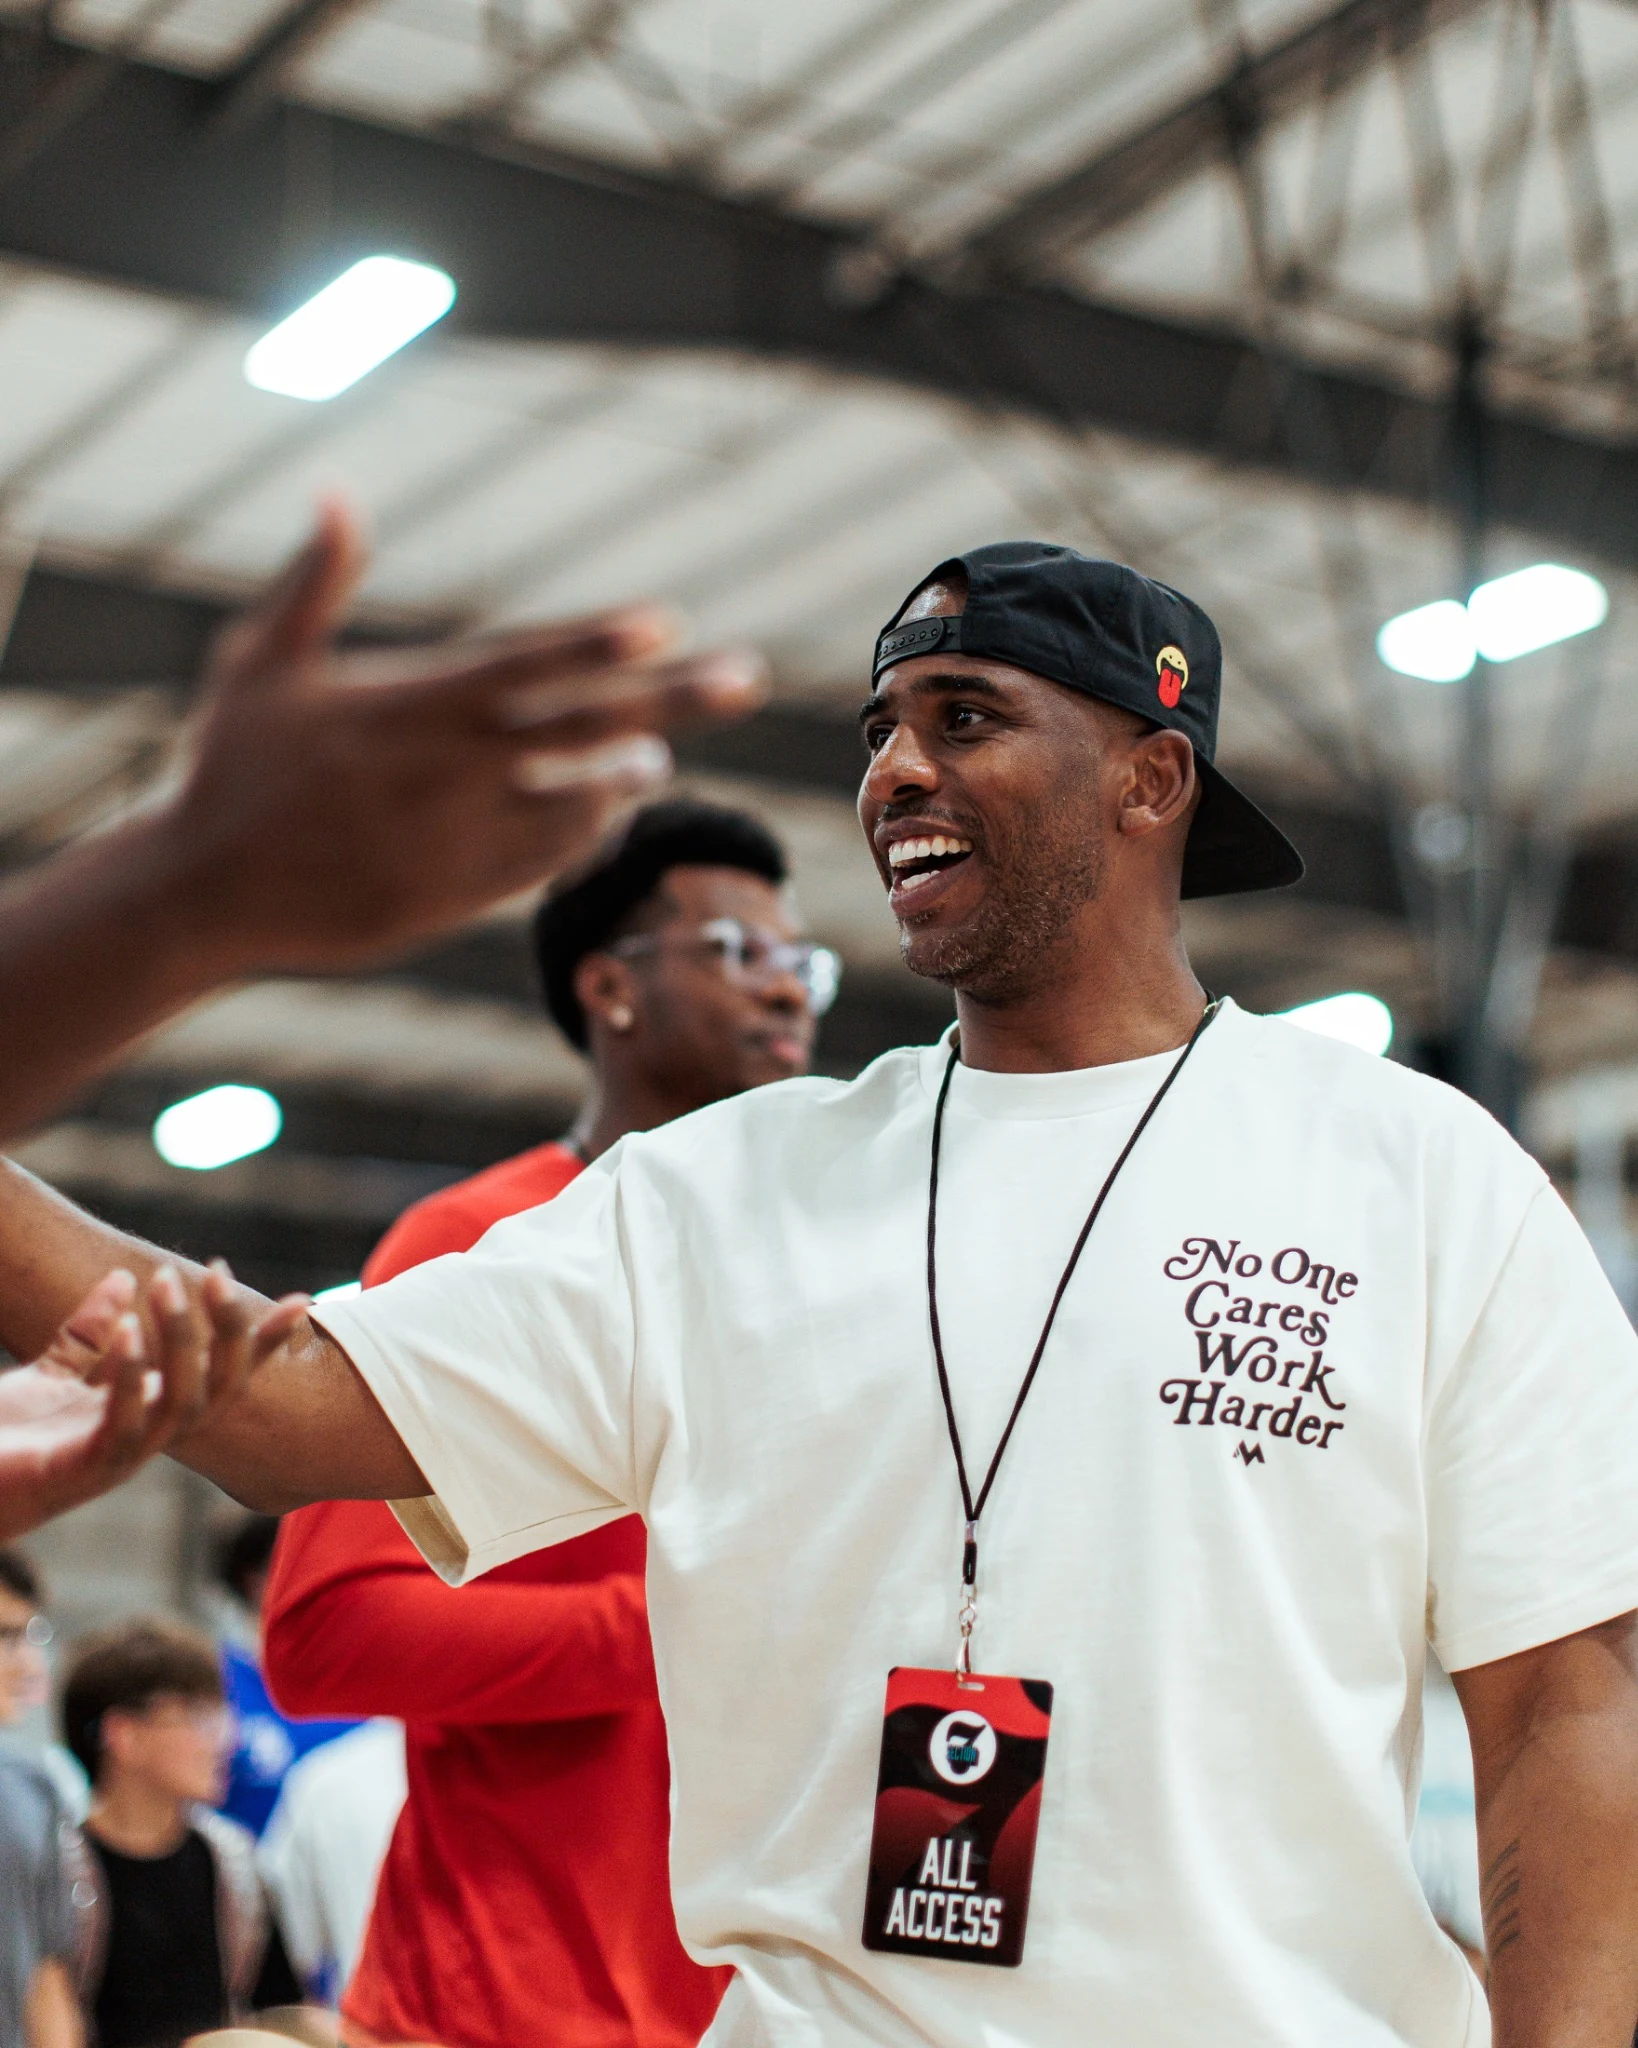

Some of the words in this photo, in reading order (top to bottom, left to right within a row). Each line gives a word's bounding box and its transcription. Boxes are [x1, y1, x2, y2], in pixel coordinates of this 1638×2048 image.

[1163, 1237, 1262, 1280] No
[1271, 1247, 1359, 1305] One
[1184, 1280, 1330, 1347] Cares
[1194, 1330, 1347, 1411] Work
[1159, 1379, 1345, 1449] Harder
[919, 1837, 977, 1890] ALL
[885, 1887, 1003, 1947] ACCESS
